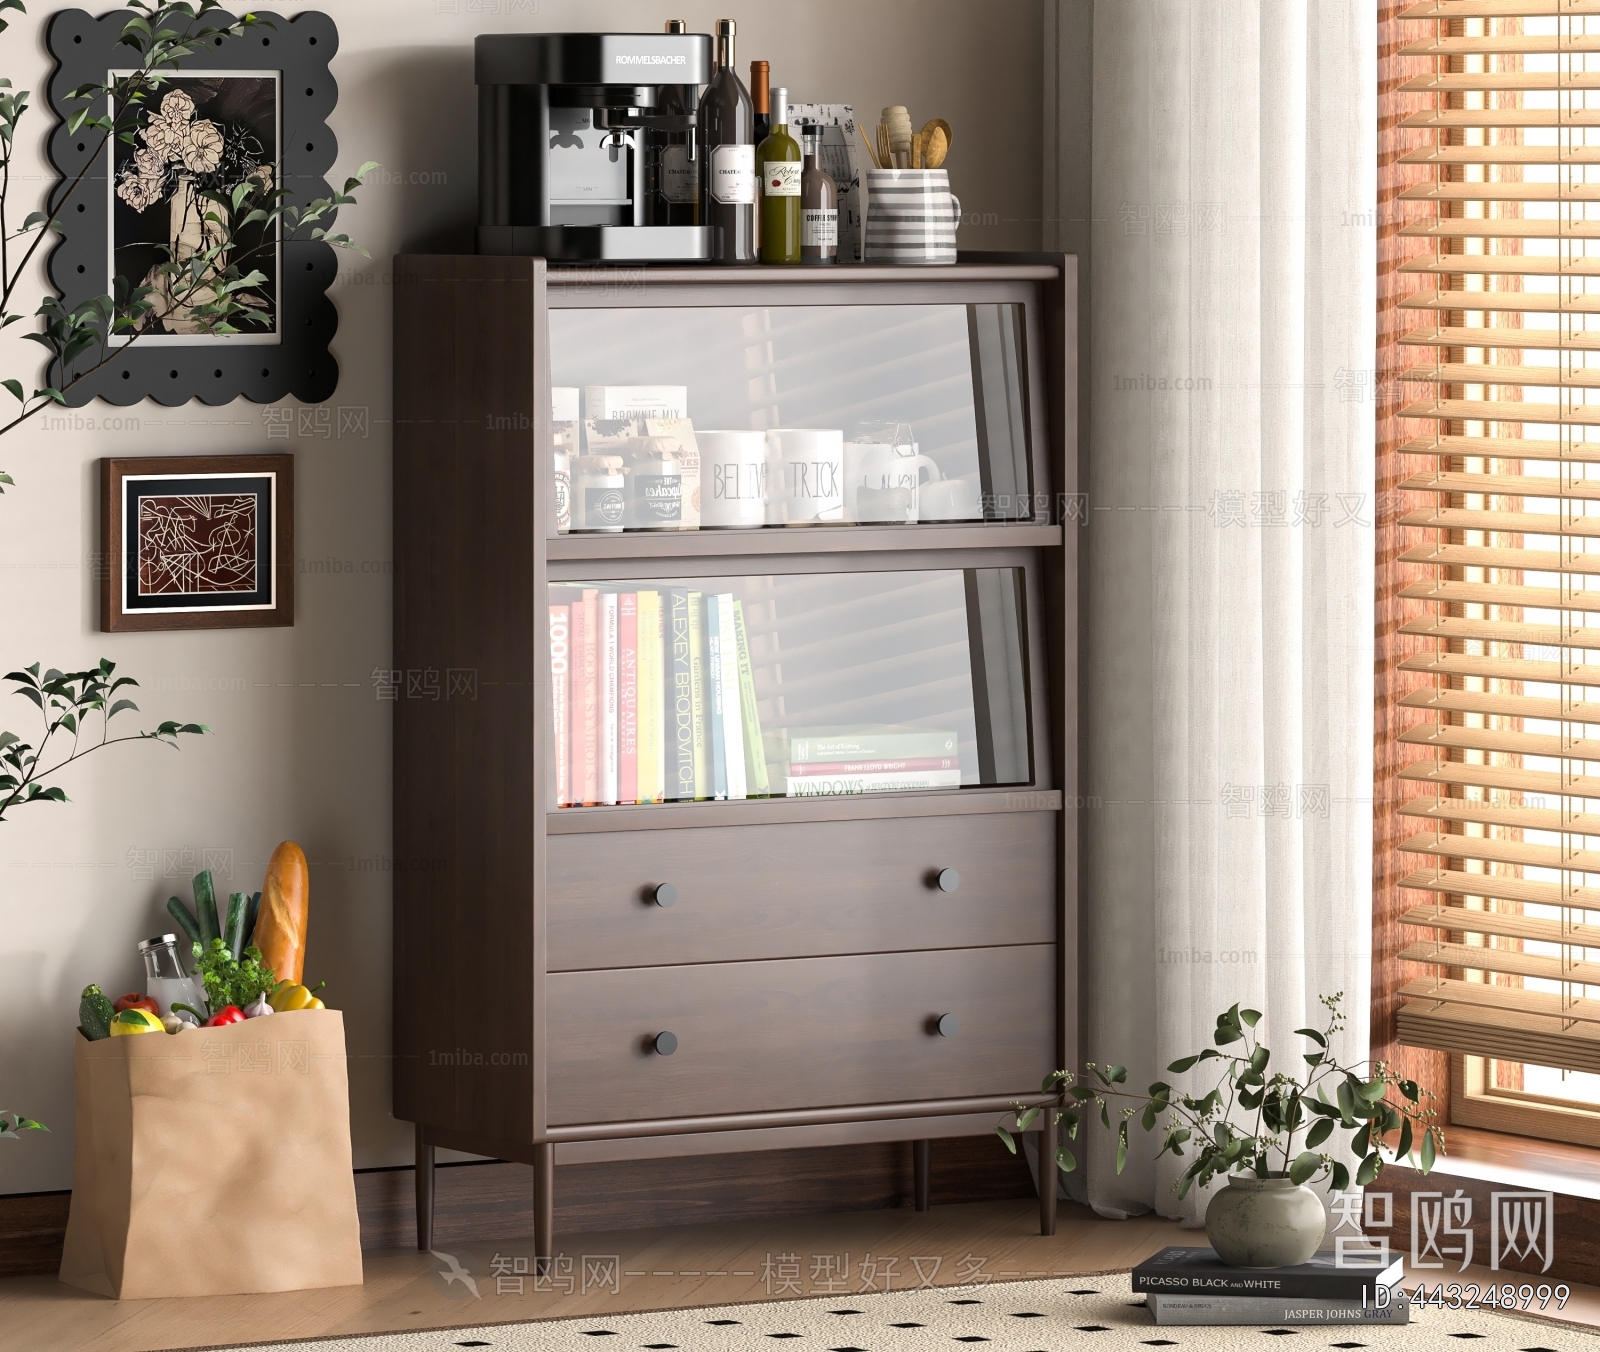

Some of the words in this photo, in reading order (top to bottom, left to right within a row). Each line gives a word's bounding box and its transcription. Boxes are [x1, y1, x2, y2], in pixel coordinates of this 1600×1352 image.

[615, 55, 687, 65] ROMMELSBACHER
[789, 462, 840, 497] TRICK
[549, 612, 569, 675] 1000
[672, 593, 690, 666] ALEXEY
[733, 609, 747, 660] MAKING
[740, 662, 750, 676] IT
[693, 656, 702, 699] Gardens
[625, 647, 637, 755] ANTIQUAIRES
[694, 701, 703, 711] in
[675, 672, 694, 795] BRODOVITCH
[695, 714, 704, 748] France
[792, 779, 864, 798] WINDOWS
[1139, 1276, 1189, 1286] PICASSO
[1192, 1278, 1229, 1288] BLACK
[1243, 1279, 1281, 1289] WHITE
[1284, 1309, 1325, 1321] JASPER
[1325, 1309, 1362, 1321] JOHNS
[1363, 1309, 1394, 1320] GRAY
